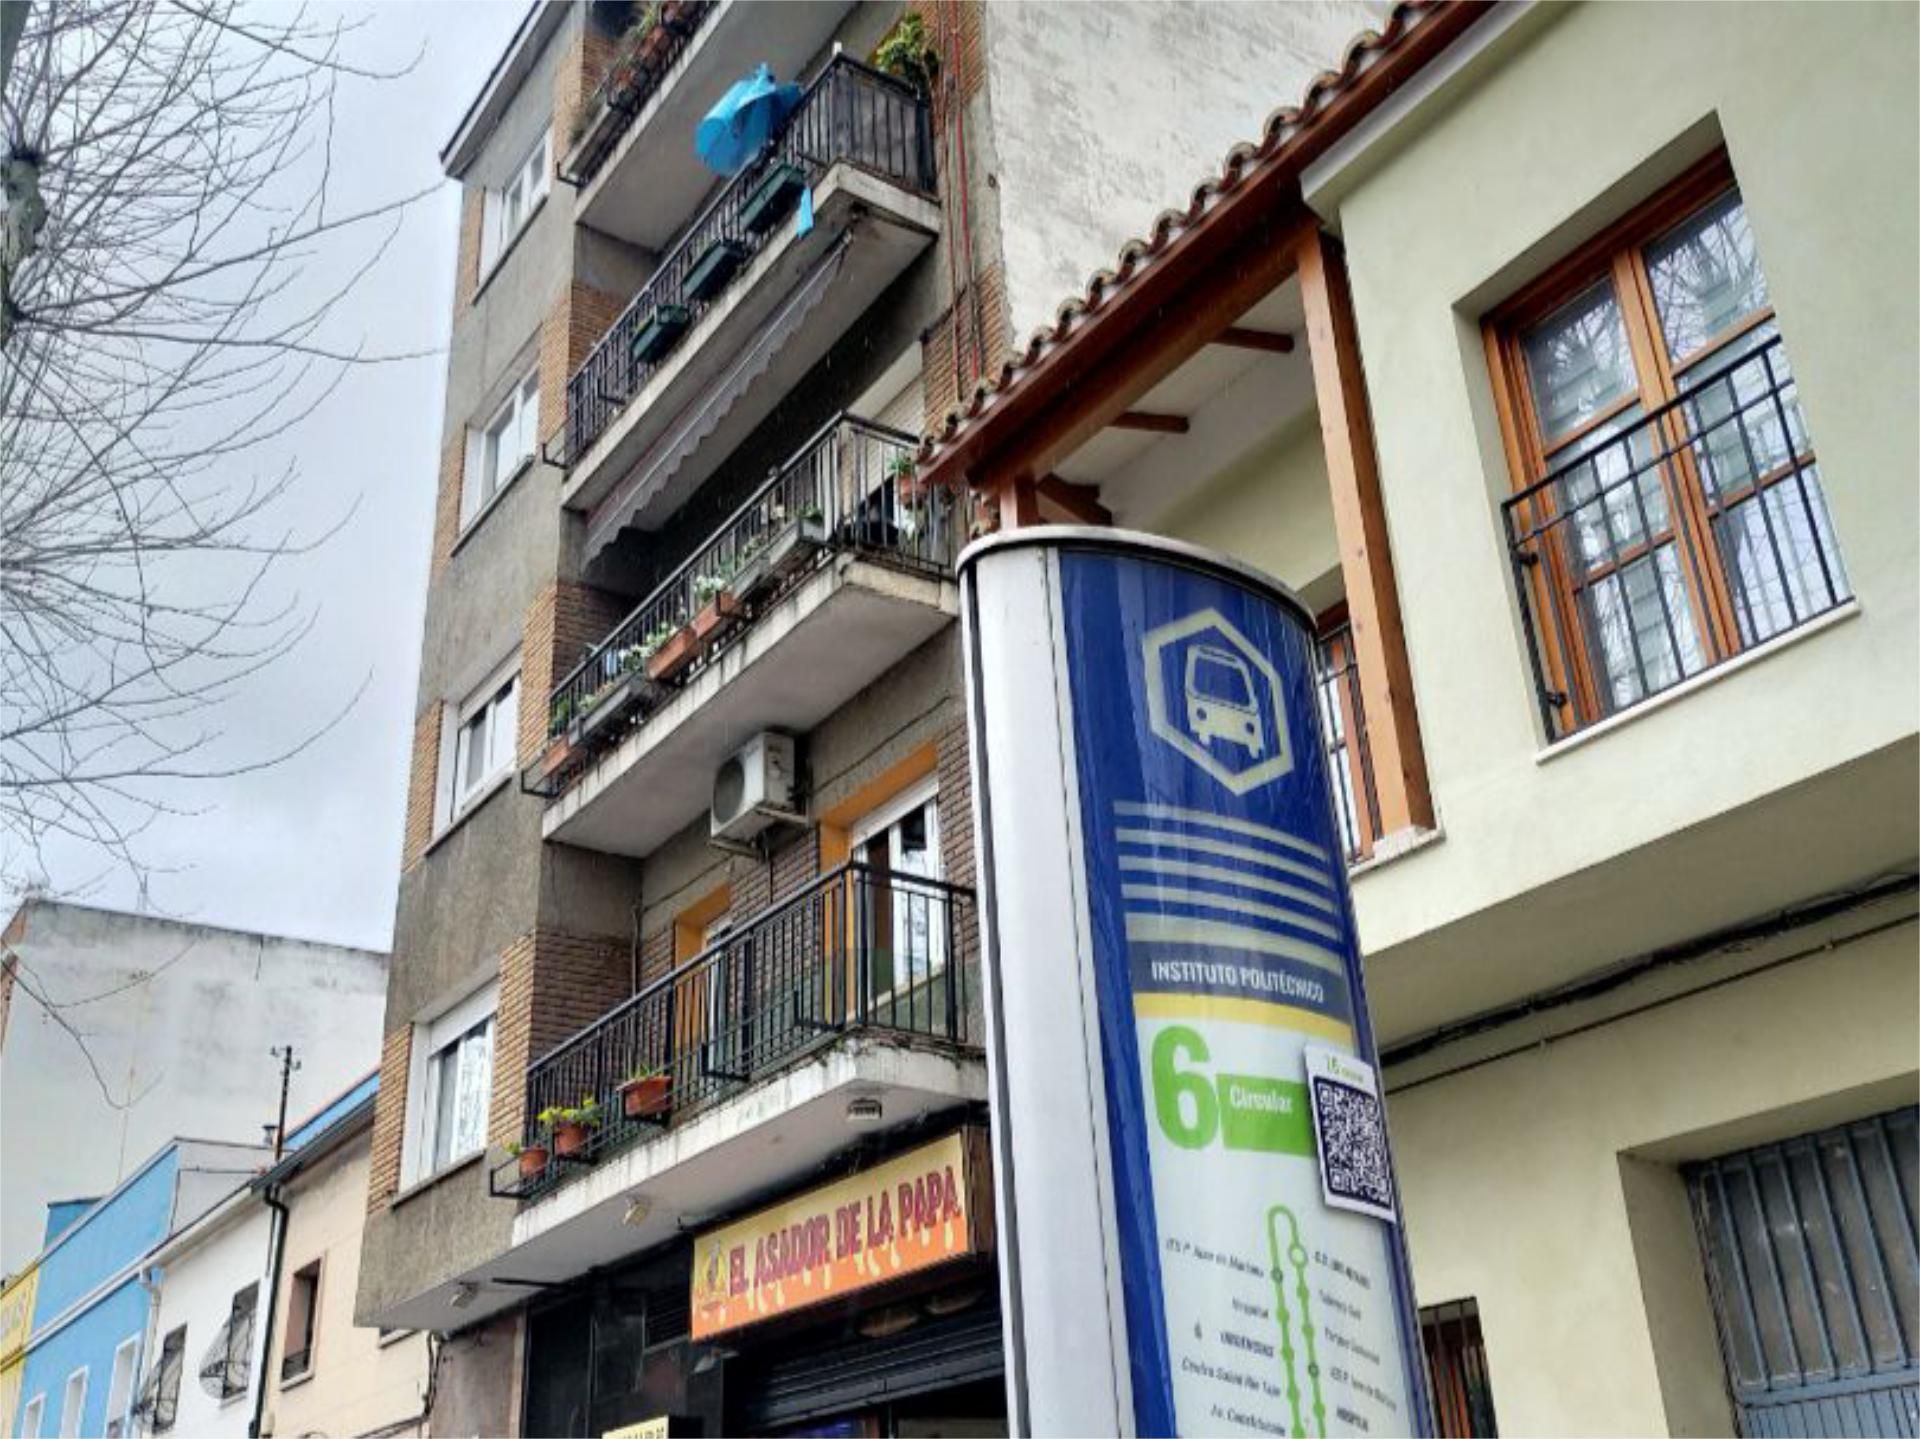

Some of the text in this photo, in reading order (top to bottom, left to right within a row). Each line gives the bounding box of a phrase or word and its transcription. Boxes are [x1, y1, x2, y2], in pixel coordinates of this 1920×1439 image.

[1151, 961, 1325, 1003] INSTITUTO POLITÉCNICO
[1151, 1024, 1293, 1149] 6 Circular
[729, 1164, 962, 1297] EL ASADOR DE LA PAPA
